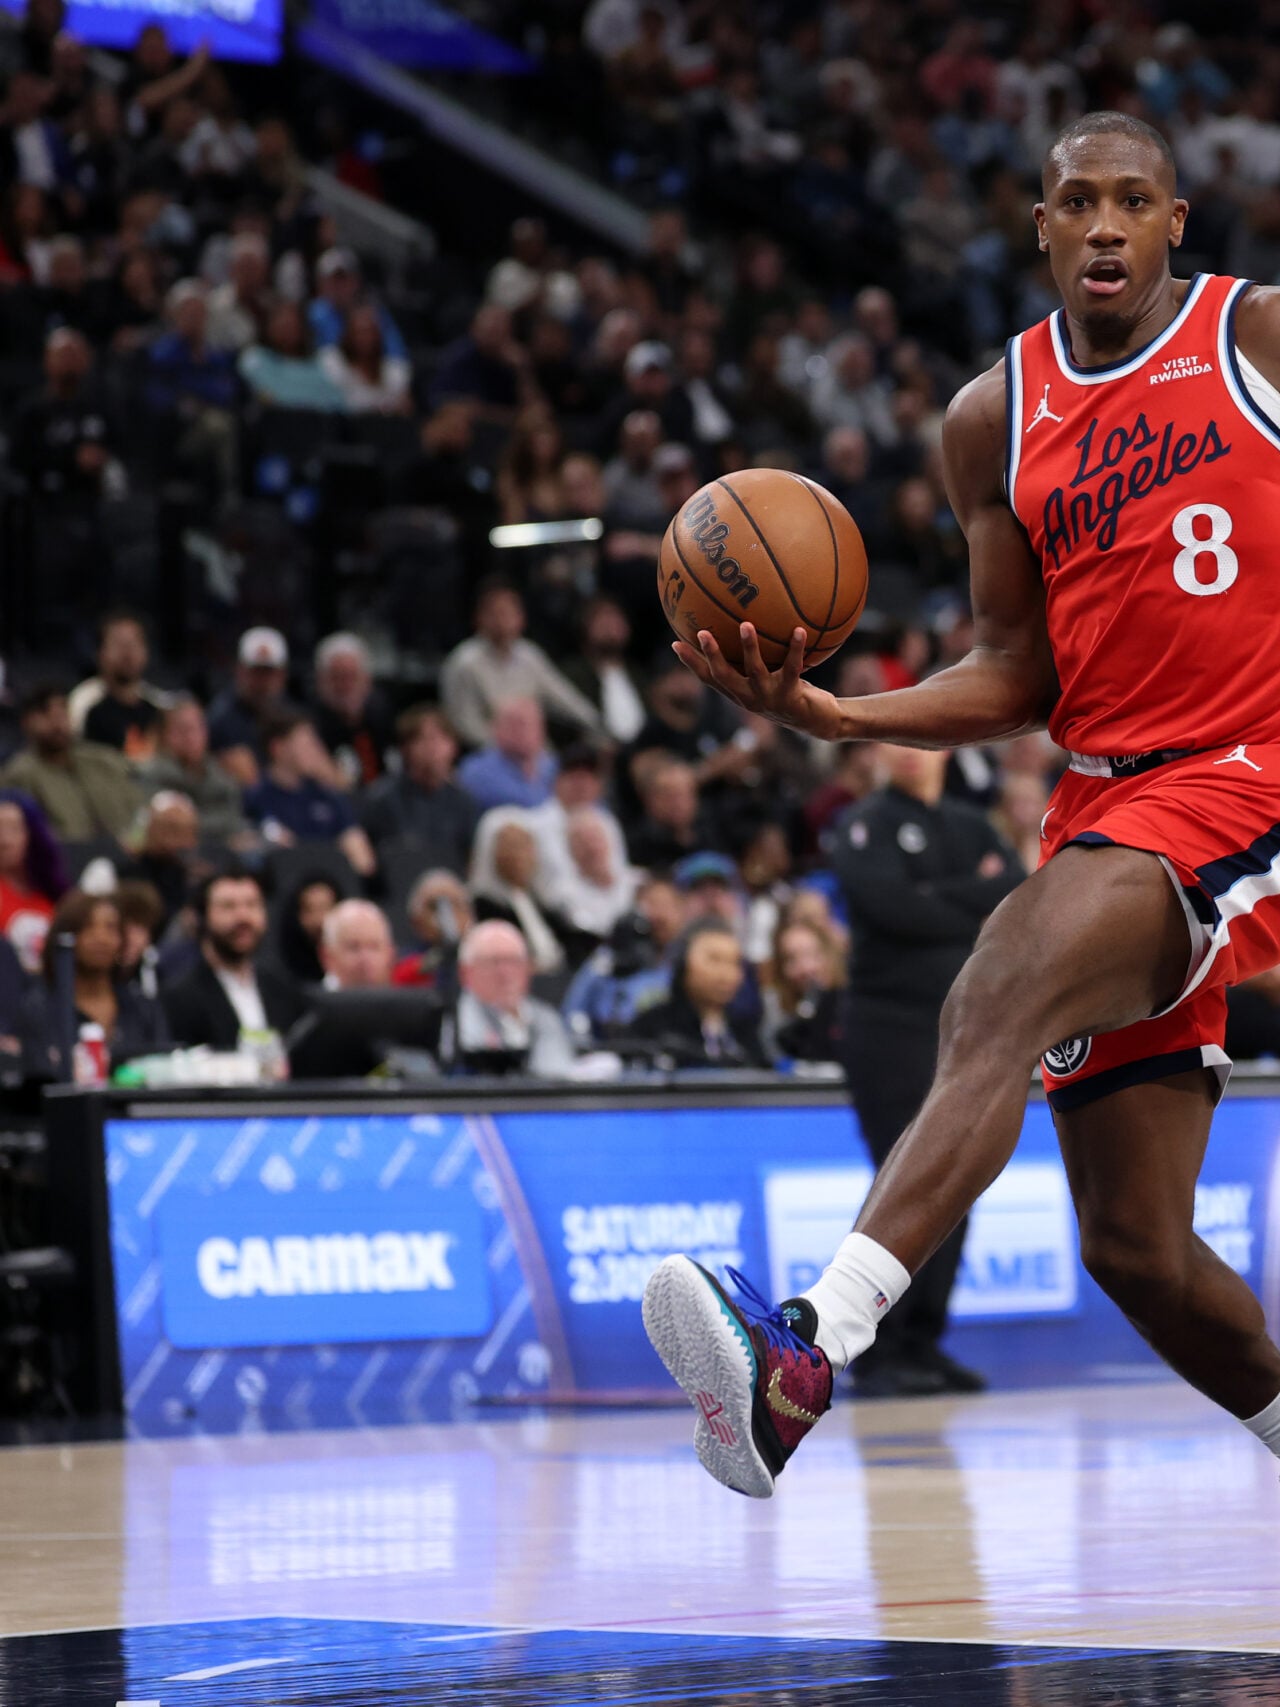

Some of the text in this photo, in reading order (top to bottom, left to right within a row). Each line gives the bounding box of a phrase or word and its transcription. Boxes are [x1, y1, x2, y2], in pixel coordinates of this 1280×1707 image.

[1149, 362, 1213, 385] RWANDA
[1162, 355, 1199, 371] VISIT
[1069, 412, 1158, 489] Los
[1043, 420, 1231, 571] Angeles
[682, 490, 760, 610] Wilson
[1172, 503, 1239, 596] 8
[561, 1202, 743, 1253] SATURDAY
